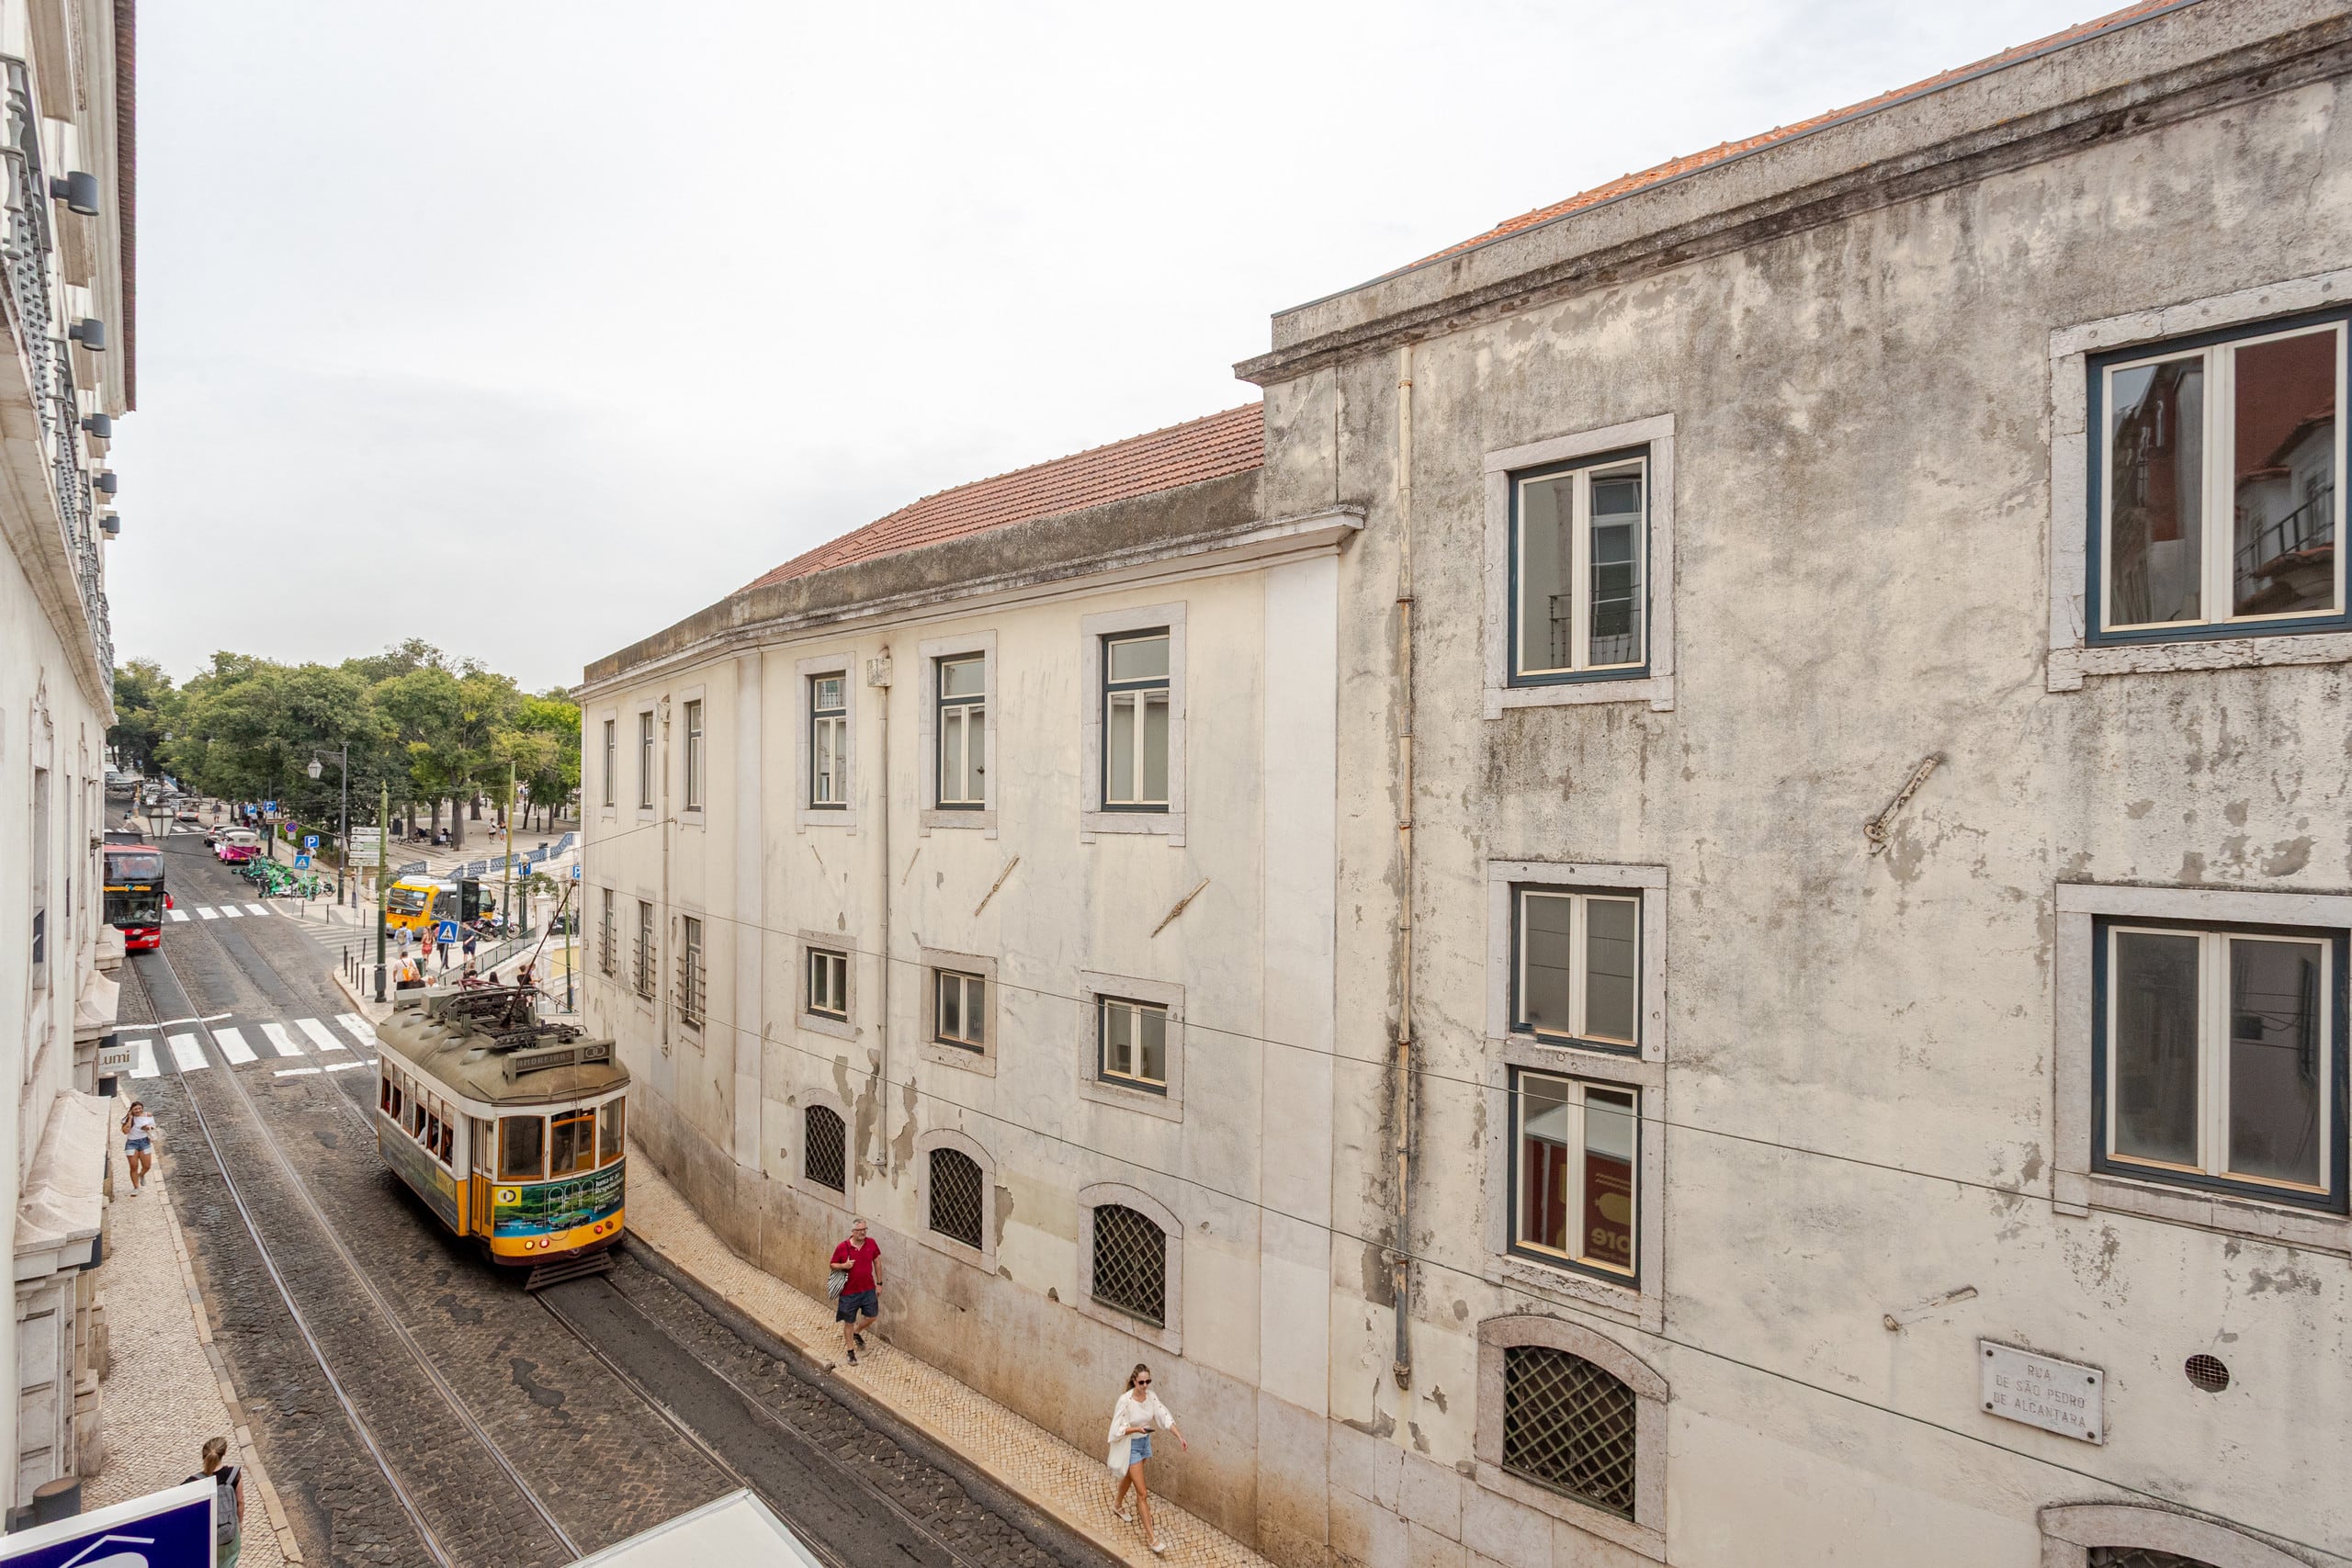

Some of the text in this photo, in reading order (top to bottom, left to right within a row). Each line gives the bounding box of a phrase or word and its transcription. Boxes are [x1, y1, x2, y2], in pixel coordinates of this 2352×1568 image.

[308, 837, 316, 848] P
[2028, 1364, 2051, 1381] RUA
[1993, 1392, 2007, 1405] DE
[1996, 1374, 2085, 1409] DE SÃO PEDRO
